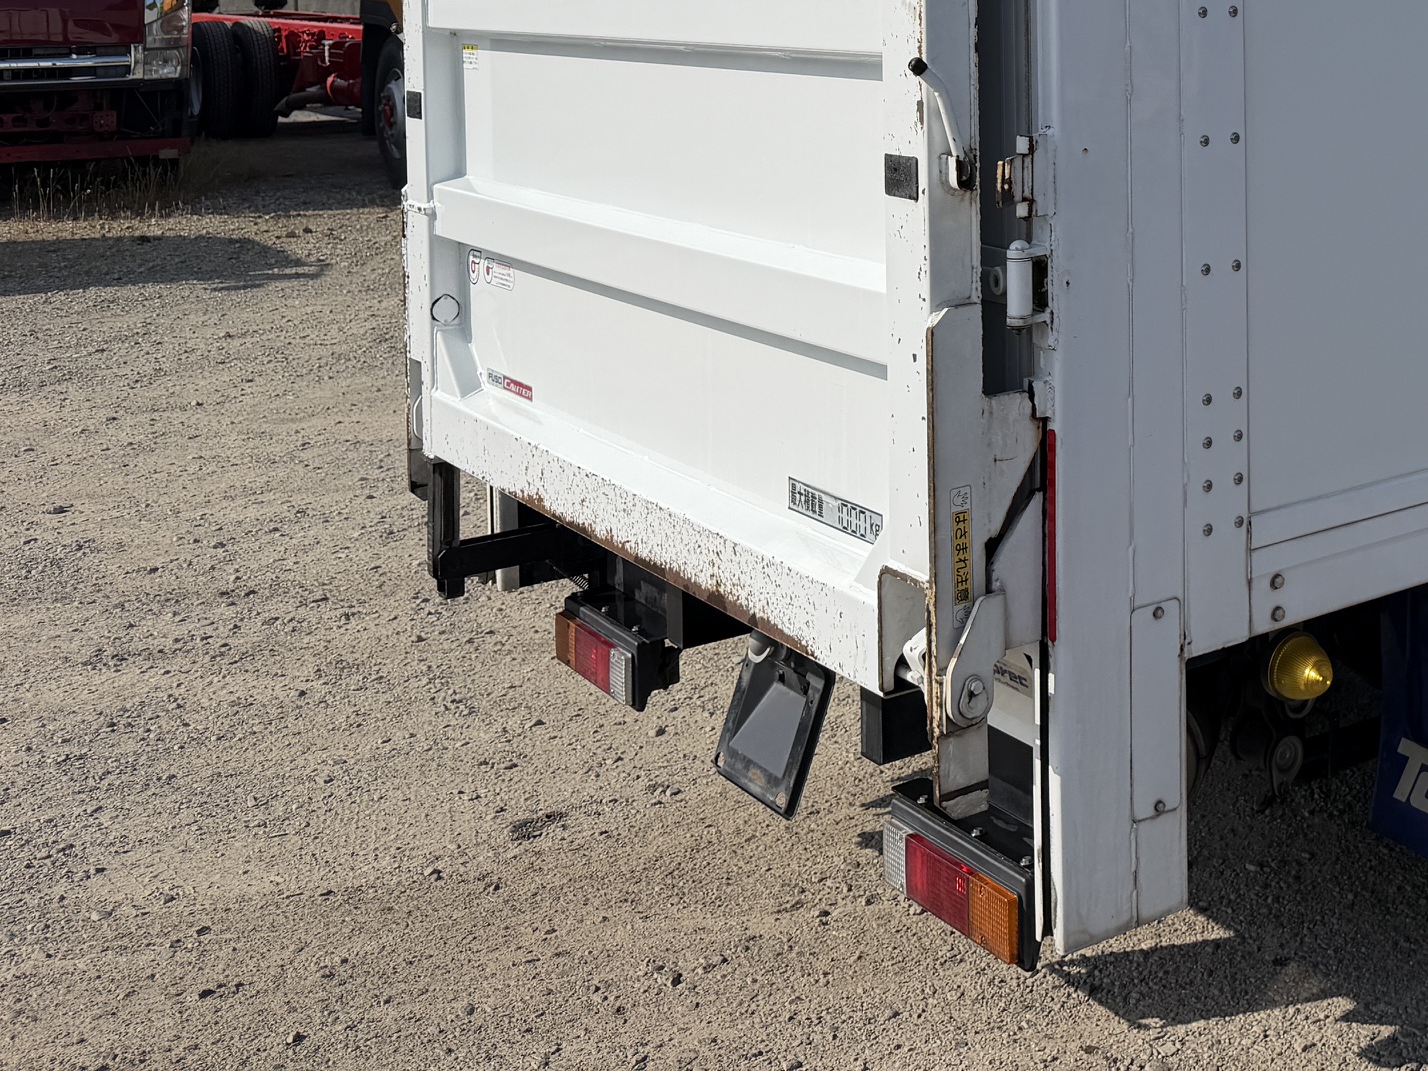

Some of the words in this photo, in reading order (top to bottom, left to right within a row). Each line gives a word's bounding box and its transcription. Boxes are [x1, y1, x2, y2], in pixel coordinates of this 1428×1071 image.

[504, 378, 532, 398] CANTER
[791, 482, 824, 519] 最大積載量
[954, 510, 970, 604] はさまれ注意
